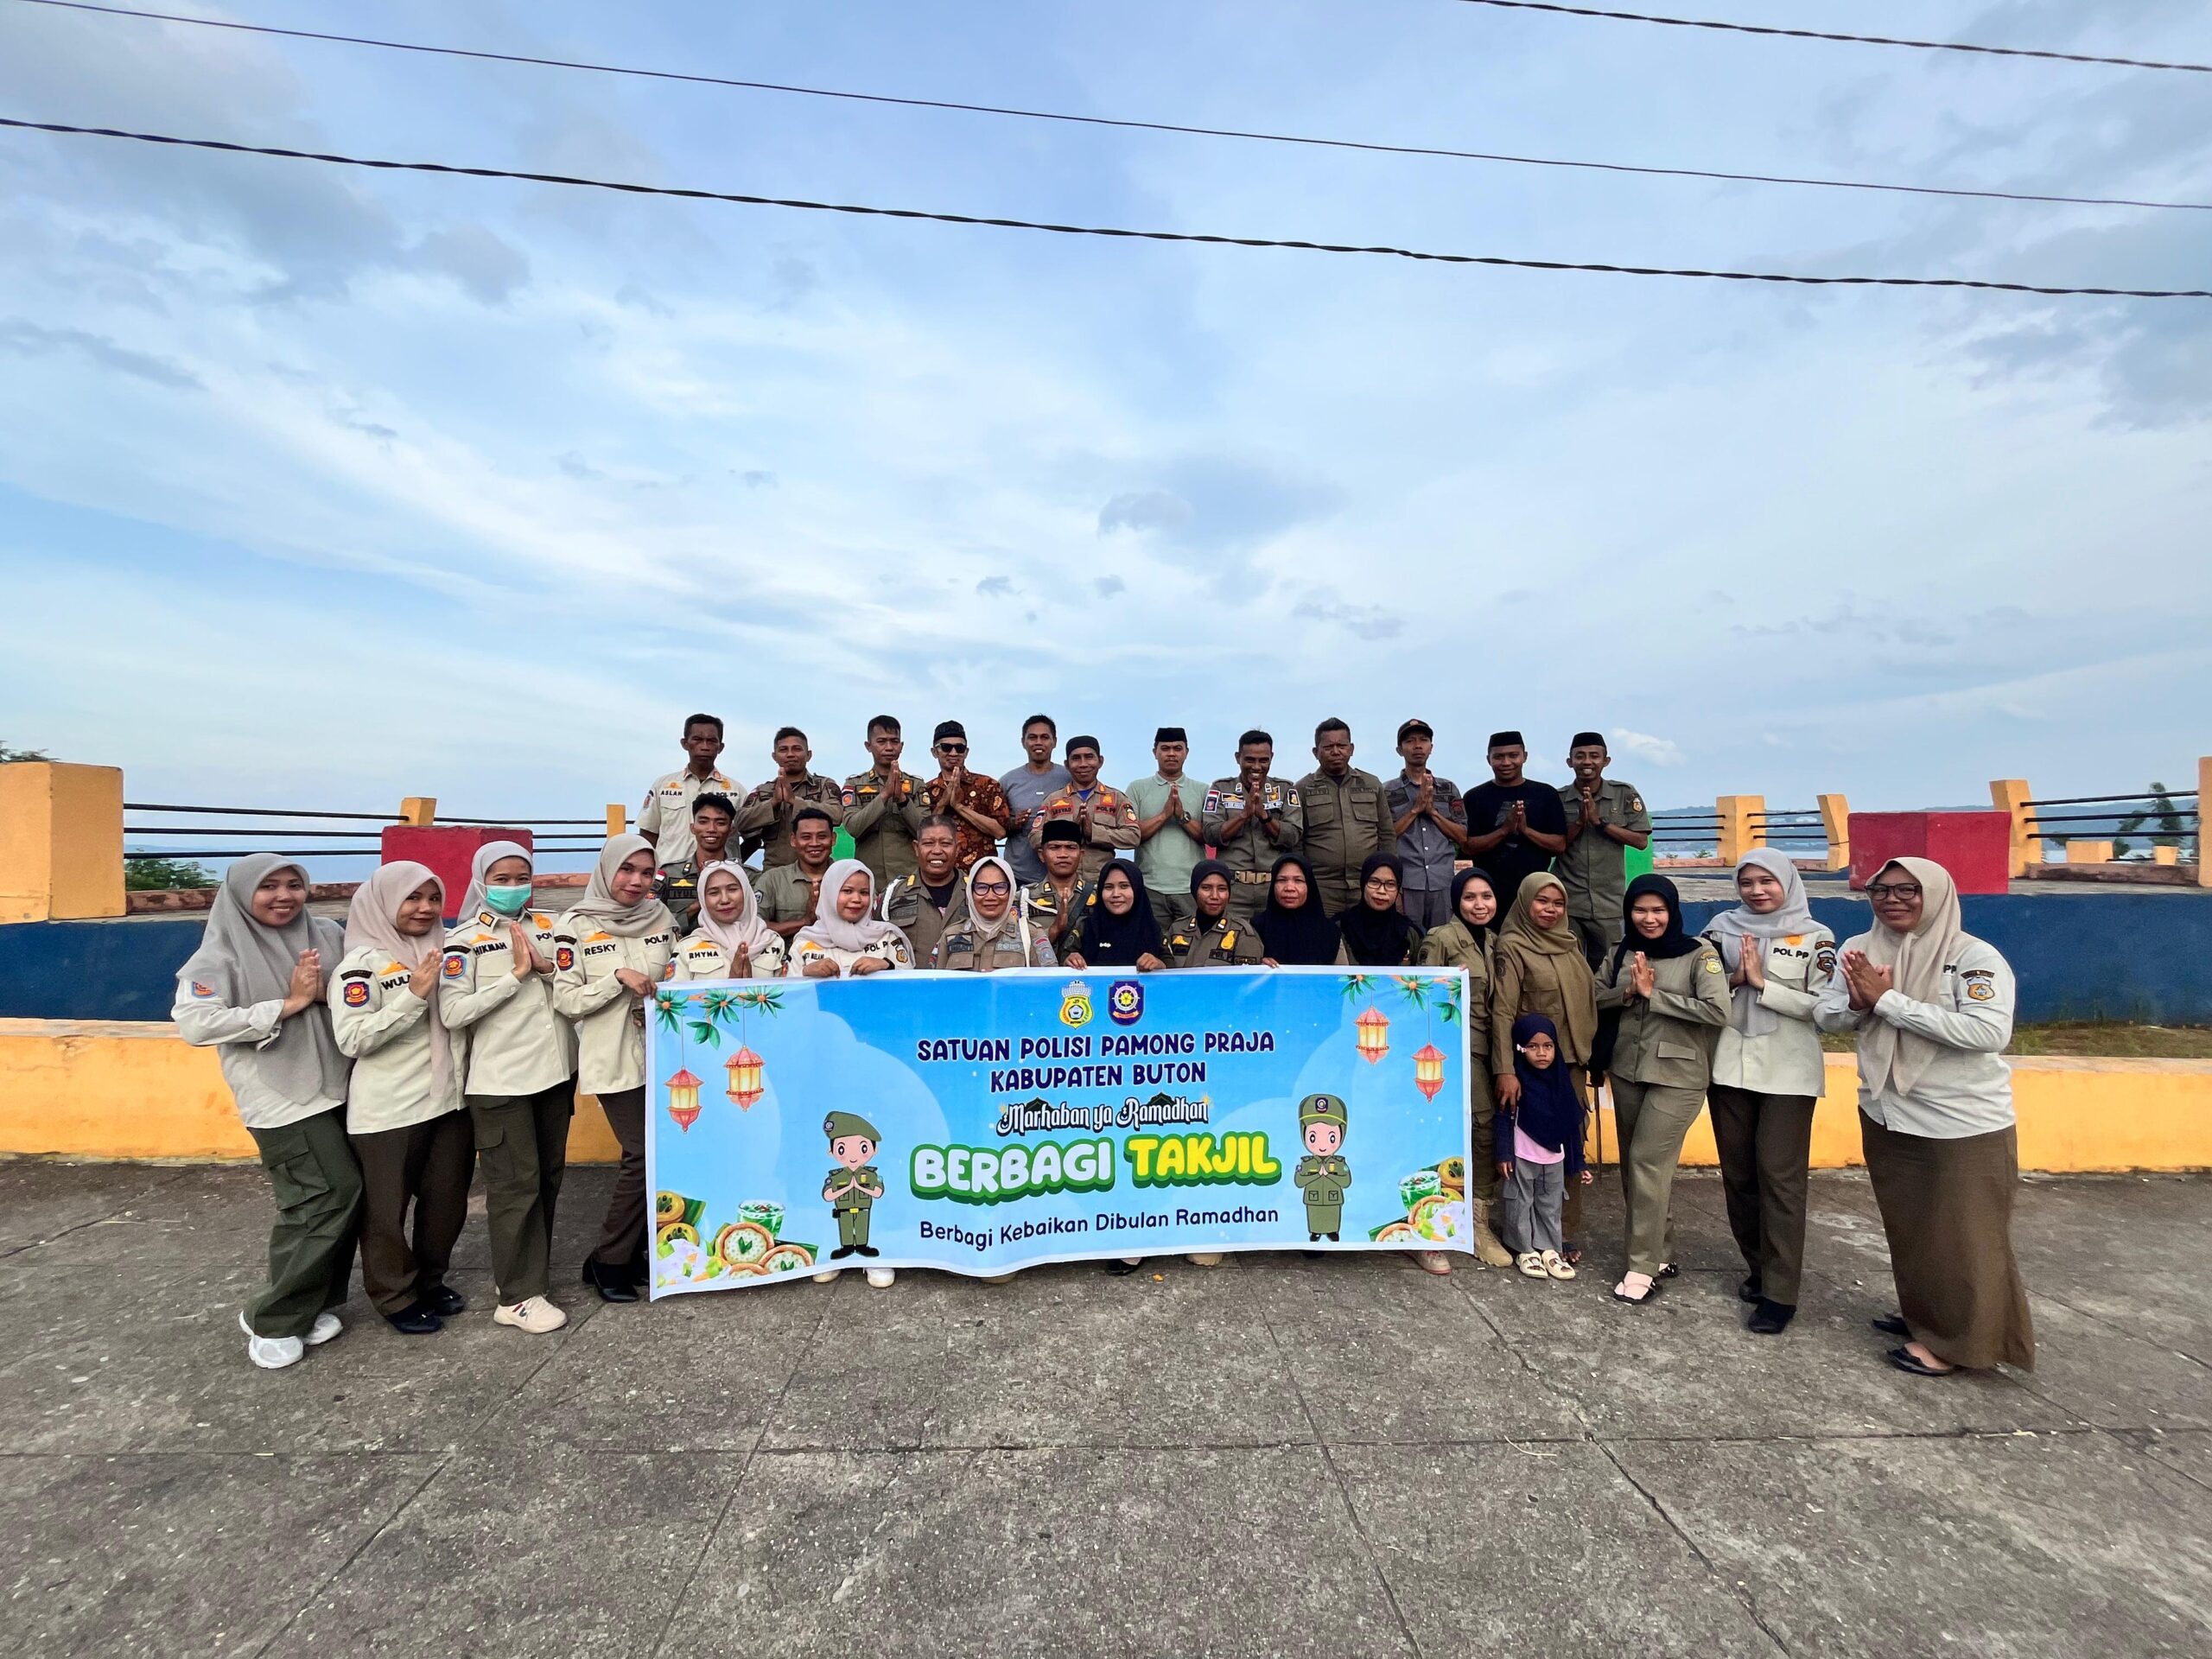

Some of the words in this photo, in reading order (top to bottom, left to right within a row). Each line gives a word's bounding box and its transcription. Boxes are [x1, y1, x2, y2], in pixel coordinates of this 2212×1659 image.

[644, 935, 661, 945] POL
[473, 942, 508, 957] HIKMAH
[584, 944, 617, 957] RESKY
[864, 943, 880, 953] POL
[1773, 947, 1793, 957] POL
[1796, 950, 1809, 959] PP
[689, 951, 719, 960] RHYNA
[1942, 964, 1957, 974] PP
[917, 1039, 1010, 1062] SATUAN
[1020, 1036, 1091, 1059] POLISI
[1101, 1033, 1195, 1057] PAMONG
[1205, 1031, 1274, 1053] PRAJA
[990, 1065, 1122, 1093] KABUPATEN
[1133, 1061, 1206, 1085] BUTON
[996, 1101, 1090, 1136] Marhaban
[1093, 1104, 1113, 1133] ya
[1116, 1096, 1210, 1131] Ramadhan
[912, 1140, 1116, 1198] BERBAGI
[1127, 1135, 1279, 1179] TAKJIL
[920, 1220, 993, 1252] Berbagi
[1000, 1217, 1089, 1245] Kebaikan
[1096, 1211, 1169, 1231] Dibulan
[1176, 1205, 1279, 1226] Ramadhan
